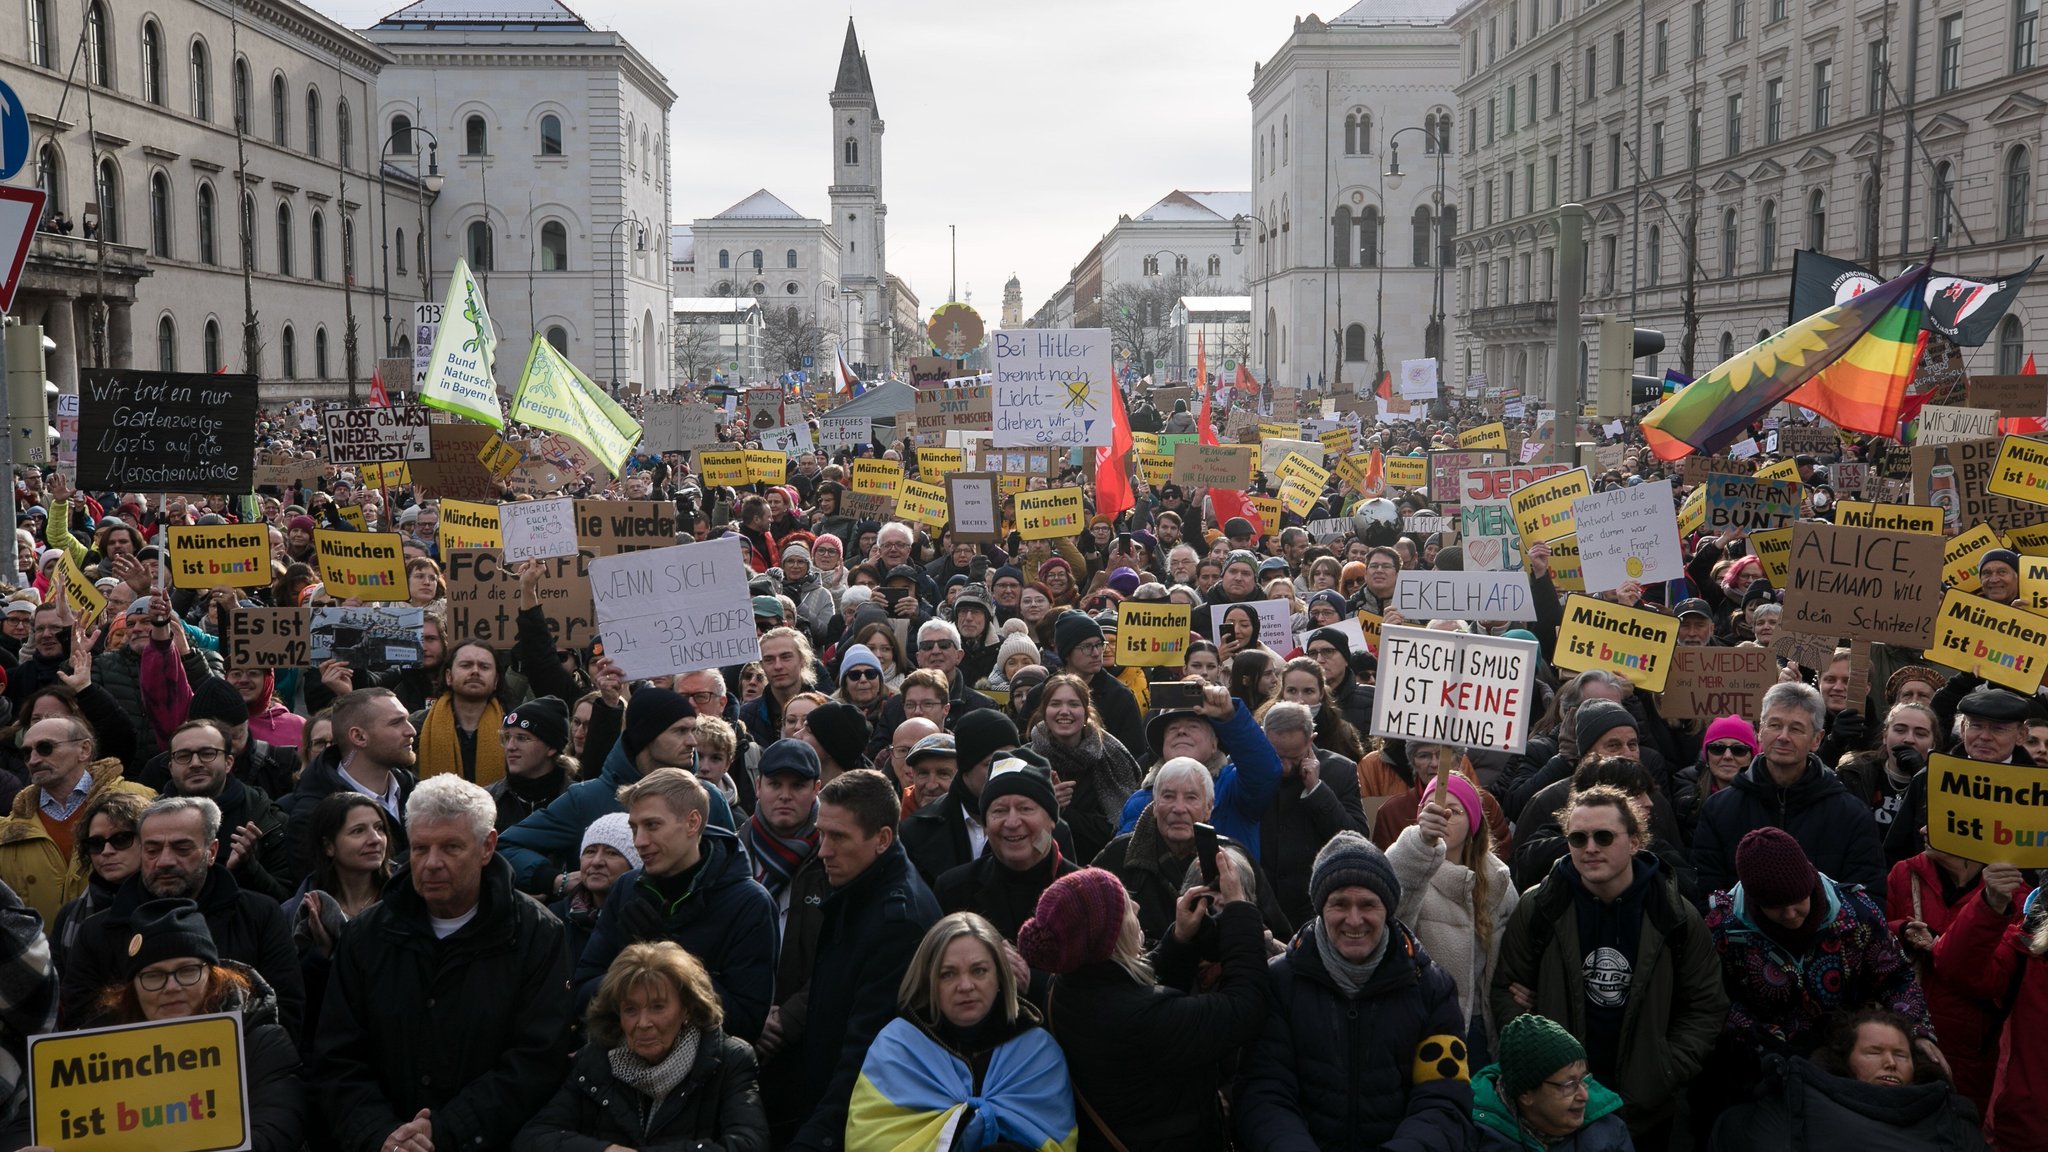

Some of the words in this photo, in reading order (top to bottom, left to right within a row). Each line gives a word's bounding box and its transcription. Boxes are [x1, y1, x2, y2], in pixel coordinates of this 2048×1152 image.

[417, 305, 444, 323] 193
[996, 334, 1026, 358] Bei
[1038, 333, 1095, 358] Hitler
[448, 353, 476, 370] Bund
[998, 363, 1046, 382] brennt
[1049, 365, 1090, 382] noch
[90, 377, 129, 401] Wir
[201, 389, 232, 405] nur
[440, 378, 451, 389] in
[452, 383, 488, 403] Bayern
[998, 386, 1043, 407] Licht
[940, 401, 969, 412] STATT
[113, 406, 223, 435] Gartenzwerge
[328, 414, 345, 429] Ob
[346, 410, 376, 428] OST
[378, 412, 393, 426] Ob
[391, 408, 430, 428] WEST
[917, 415, 947, 428] RECHTE
[953, 412, 993, 426] MENSCHEN
[997, 410, 1043, 431] drehen
[1049, 413, 1070, 428] wir
[1966, 415, 1994, 435] ALLE
[332, 428, 382, 444] NIEDER
[384, 431, 399, 441] mit
[401, 430, 417, 441] der
[823, 432, 863, 440] WELCOME
[1036, 430, 1054, 443] es
[1062, 419, 1096, 443] ab!
[1321, 432, 1348, 441] München
[1462, 430, 1500, 447] München
[97, 429, 155, 453] Nazis
[166, 433, 198, 461] auf
[198, 435, 222, 455] die
[333, 443, 407, 462] NAZIPEST
[1962, 442, 1997, 460] DIE
[704, 456, 741, 466] München
[745, 454, 782, 464] München
[920, 453, 962, 462] München
[1390, 461, 1424, 470] München
[106, 457, 239, 483] Menschenwürde
[707, 470, 718, 479] ist
[718, 469, 742, 479] bunt!
[757, 467, 780, 477] bunt!
[857, 464, 899, 475] München
[1283, 465, 1294, 475] ist
[1289, 455, 1325, 481] München
[1840, 465, 1858, 476] FCK
[2003, 468, 2023, 484] ist
[857, 479, 868, 488] ist
[870, 480, 896, 490] bunt!
[1839, 477, 1860, 488] NZS
[1020, 495, 1078, 510] München
[1518, 482, 1581, 514] München
[1574, 499, 1600, 513] Wenn
[1606, 490, 1626, 506] AfD
[1631, 488, 1645, 500] die
[1725, 483, 1791, 506] BAYERN
[506, 502, 562, 518] REMIGRIERT
[841, 507, 856, 517] DEN
[903, 500, 916, 512] ist
[918, 504, 945, 518] bunt!
[1741, 502, 1761, 510] IST
[1968, 498, 1998, 515] DIE
[443, 508, 498, 529] München
[526, 516, 548, 525] EUCH
[611, 506, 675, 538] wieder
[1024, 517, 1039, 529] ist
[1043, 515, 1077, 527] bunt!
[1523, 518, 1541, 535] ist
[1576, 511, 1614, 530] Antwort
[1621, 508, 1639, 518] sein
[1644, 504, 1658, 516] soll
[1712, 508, 1794, 528] BUNT
[1843, 512, 1934, 531] München
[532, 524, 545, 532] INS
[1579, 532, 1594, 544] wie
[1600, 527, 1624, 538] dumm
[1631, 525, 1648, 533] war
[176, 535, 261, 550] München
[321, 540, 395, 559] München
[444, 534, 455, 548] ist
[1582, 548, 1603, 561] dann
[1609, 545, 1622, 555] die
[1630, 534, 1660, 556] Frage?
[1798, 531, 1916, 578] ALICE,
[183, 559, 204, 575] ist
[209, 557, 259, 575] bunt!
[1772, 563, 1787, 576] ist
[327, 566, 344, 584] ist
[346, 568, 395, 587] bunt!
[592, 569, 653, 602] WENN
[665, 561, 716, 593] SICH
[1795, 567, 1882, 599] NIEMAND
[452, 586, 477, 600] und
[488, 585, 506, 600] die
[234, 613, 264, 635] Es
[272, 611, 303, 635] ist
[688, 608, 752, 637] WIEDER
[1125, 612, 1187, 627] München
[1571, 607, 1667, 643] München
[1797, 601, 1831, 624] dein
[1848, 606, 1932, 640] Schnitzel?
[1949, 601, 2047, 647] München
[234, 640, 250, 665] 5
[1128, 637, 1147, 651] ist
[1152, 637, 1183, 652] bunt!
[1569, 635, 1595, 657] ist
[1600, 643, 1657, 672] bunt!
[1943, 630, 1970, 652] ist
[1974, 640, 2034, 674] bunt!
[1388, 638, 1521, 680] FASCHISMUS
[1700, 653, 1767, 673] WIEDER
[1699, 676, 1724, 688] MEHR
[1393, 676, 1433, 704] IST
[1440, 680, 1519, 717] KEINE
[1691, 692, 1754, 717] WORTE
[1947, 810, 1983, 840] ist
[51, 1044, 221, 1088] München
[61, 1107, 106, 1140] ist
[116, 1090, 216, 1134] bunt!
